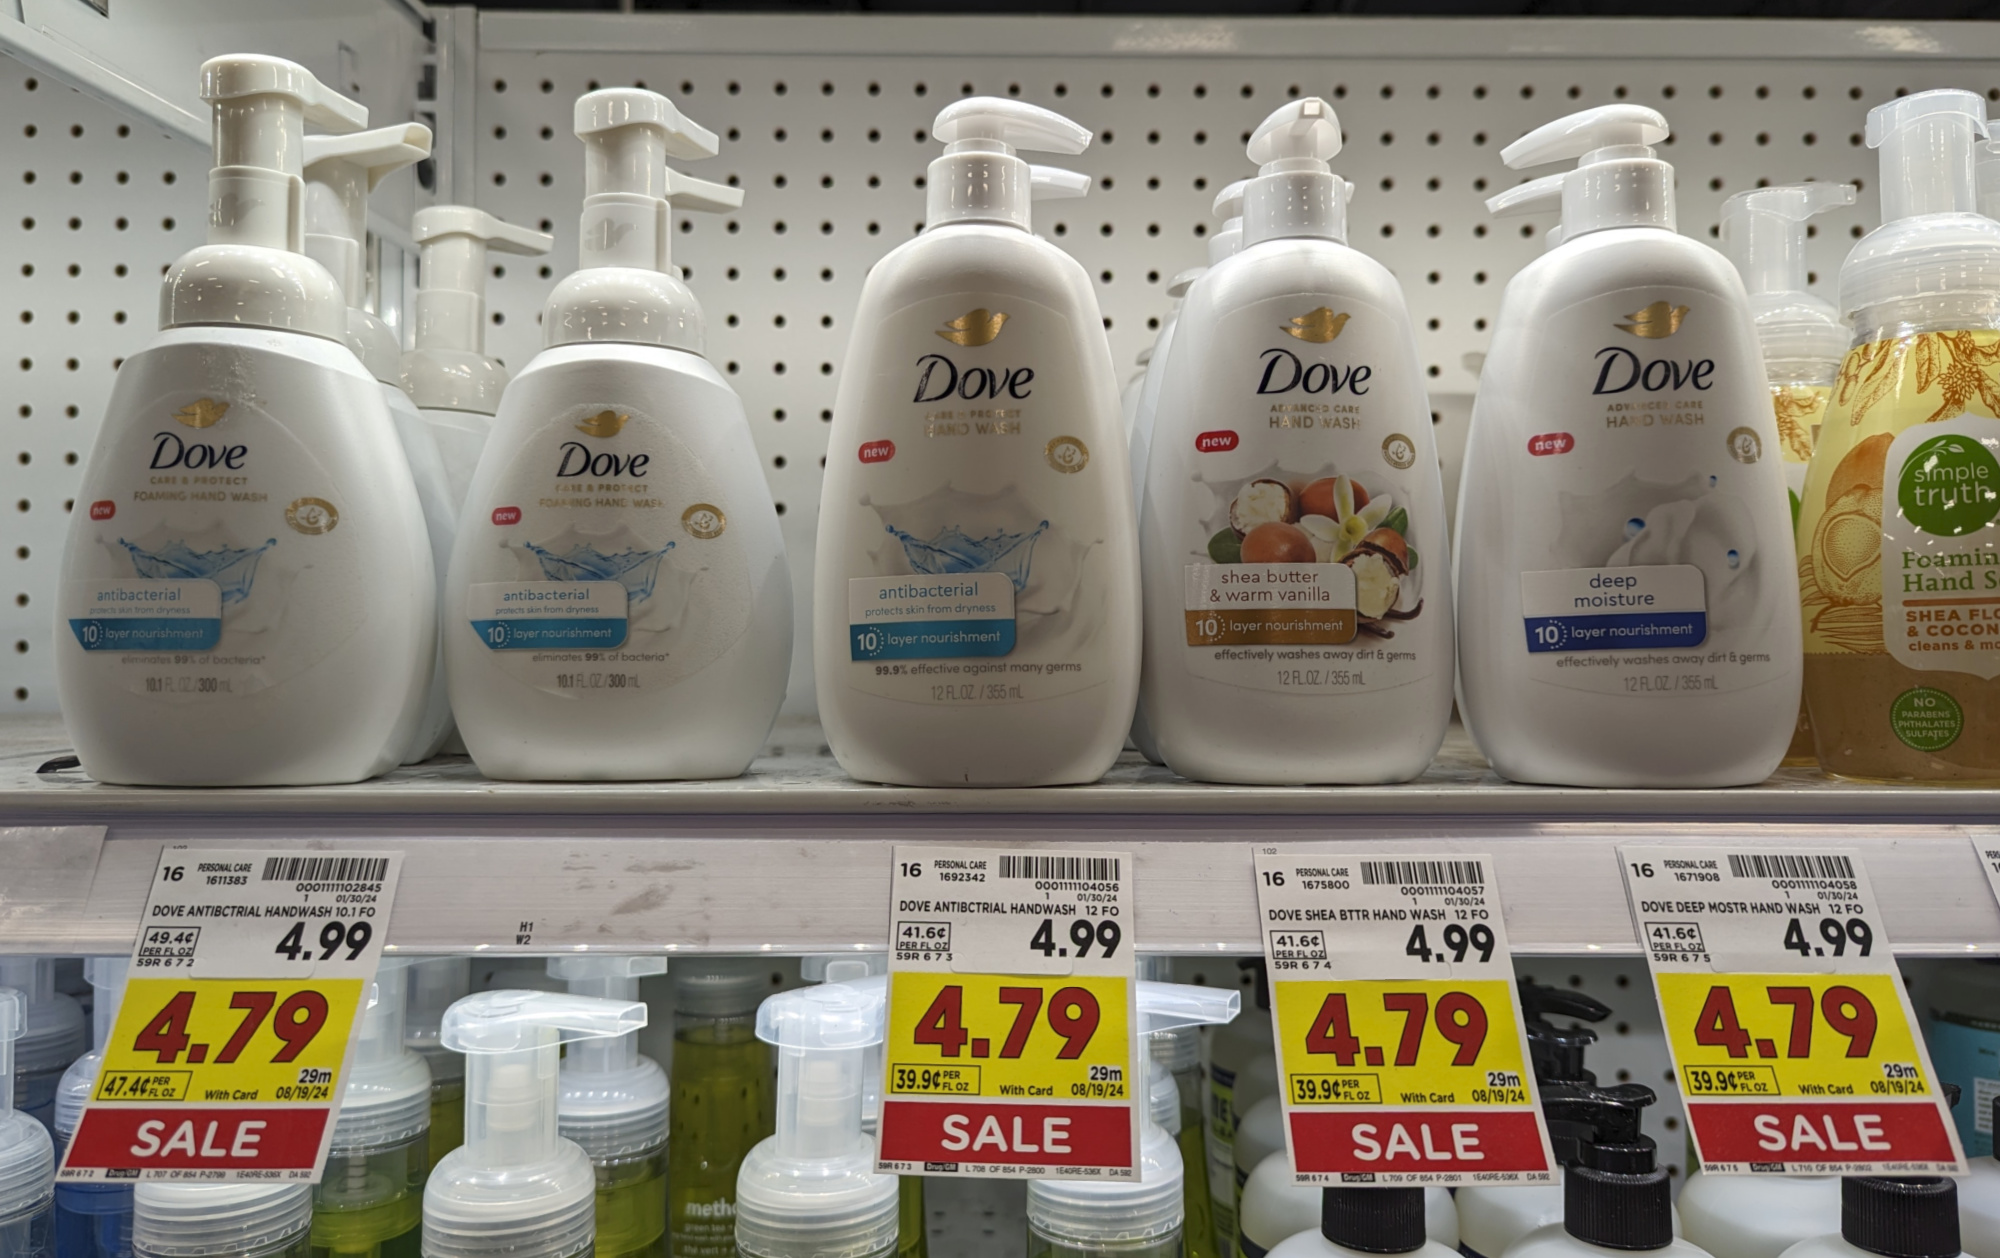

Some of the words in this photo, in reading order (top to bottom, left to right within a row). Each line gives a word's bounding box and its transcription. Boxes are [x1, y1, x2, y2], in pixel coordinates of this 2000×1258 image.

[1257, 349, 1372, 395] Dove
[1592, 346, 1715, 395] Dove
[913, 354, 1035, 403] Dove
[1202, 435, 1232, 448] new
[1535, 438, 1567, 450] new
[150, 432, 248, 469] Dove
[864, 446, 889, 458] new
[557, 442, 649, 477] Dove
[1914, 462, 1989, 483] simple
[1914, 481, 1992, 506] truth
[1221, 570, 1260, 584] shea
[1267, 569, 1319, 583] butter
[1590, 574, 1637, 591] deep
[1903, 571, 1975, 592] Hand
[97, 588, 181, 601] antibacterial
[504, 589, 590, 601] antibacterial
[879, 581, 978, 600] antibacterial
[1210, 589, 1221, 602] &
[1226, 590, 1273, 602] warm
[1278, 587, 1330, 601] vanilla
[1574, 592, 1655, 608] moisture
[1906, 610, 1961, 622] SHEA
[82, 625, 97, 643] 10
[105, 628, 130, 640] layer
[132, 628, 203, 638] nourishment
[487, 626, 504, 643] 10
[514, 628, 539, 640] layer
[542, 628, 612, 638] nourishment
[1195, 619, 1218, 636] 10
[1230, 620, 1262, 634] layer
[1265, 619, 1343, 632] nourishment
[1534, 626, 1559, 644] 10
[1571, 626, 1605, 640] layer
[1610, 623, 1693, 637] nourishment
[1907, 625, 1918, 637] &
[857, 632, 877, 651] 10
[887, 633, 918, 647] layer
[921, 631, 1001, 644] nourishment
[1908, 641, 1959, 652] cleans
[1964, 640, 1975, 650] &
[1214, 649, 1274, 662] effectively
[1277, 650, 1320, 660] washes
[1323, 651, 1354, 662] away
[1356, 650, 1375, 660] dirt
[1376, 650, 1384, 660] &
[1386, 652, 1416, 662] germs
[1556, 655, 1620, 668] effectively
[1623, 654, 1669, 665] washes
[1672, 654, 1705, 665] away
[1708, 653, 1727, 663] dirt
[1729, 653, 1737, 663] &
[1739, 653, 1771, 665] germs
[875, 664, 908, 676] 99.9%
[911, 663, 960, 675] effective
[963, 662, 1007, 676] against
[1010, 663, 1042, 675] many
[1045, 662, 1082, 674] germs
[1913, 698, 1936, 708] NO
[1905, 730, 1950, 738] SULFATES
[198, 863, 232, 872] PERSONAL
[234, 863, 252, 872] CARE
[901, 863, 922, 877] 16
[934, 860, 968, 869] PERSONAL
[970, 862, 987, 870] CARE
[1631, 863, 1655, 878] 16
[1663, 860, 1698, 869] PERSONAL
[1699, 860, 1718, 870] CARE
[163, 866, 184, 882] 16
[940, 873, 985, 882] 1692342
[1263, 872, 1285, 886] 16
[1296, 868, 1330, 877] PERSONAL
[1332, 868, 1349, 877] CARE
[1675, 873, 1720, 882] 1671908
[206, 876, 248, 885] 1611383
[1035, 882, 1119, 891] 0001111104056
[1302, 880, 1350, 890] 1675800
[1772, 880, 1857, 890] 0001111104058
[296, 883, 381, 893] 0001111102845
[1401, 886, 1484, 896] 0001111104057
[336, 894, 377, 903] 01/30/24
[1077, 893, 1117, 902] 01/30/24
[1445, 897, 1485, 906] 01/30/24
[1817, 891, 1858, 901] 01/30/24
[152, 906, 185, 917] DOVE
[187, 906, 262, 917] ANTIBCTRIAL
[265, 906, 332, 917] HANDWASH
[336, 907, 357, 917] 10.1
[359, 907, 376, 917] FO
[900, 901, 931, 912] DOVE
[934, 902, 1007, 913] ANTIBCTRIAL
[1011, 904, 1076, 915] HANDWASH
[1085, 906, 1098, 915] 12
[1102, 906, 1119, 916] FO
[1269, 909, 1302, 920] DOVE
[1305, 909, 1336, 920] SHEA
[1340, 909, 1370, 920] BTTR
[1373, 909, 1407, 920] HAND
[1410, 909, 1446, 920] WASH
[1455, 910, 1467, 920] 12
[1471, 910, 1489, 920] FO
[1641, 901, 1674, 912] DOVE
[1677, 902, 1705, 912] DEEP
[1709, 902, 1748, 913] MOSTR
[1751, 903, 1783, 914] HAND
[1786, 903, 1821, 914] WASH
[1829, 904, 1843, 914] 12
[1846, 904, 1863, 914] FO
[519, 921, 533, 932] H1
[902, 927, 946, 939] 41.6¢
[1653, 927, 1697, 940] 41.6¢
[148, 931, 194, 945] 49.4¢
[275, 921, 373, 961] 4.99
[516, 934, 531, 945] W2
[1030, 919, 1121, 958] 4.99
[1276, 935, 1320, 947] 41.6¢
[1406, 924, 1495, 963] 4.99
[1784, 918, 1873, 957] 4.99
[133, 990, 329, 1064] 4.79
[914, 985, 1100, 1060] 4.79
[1694, 985, 1878, 1058] 4.79
[1305, 991, 1489, 1067] 4.79
[299, 1069, 332, 1084] 29m
[1090, 1066, 1122, 1081] 29m
[1883, 1064, 1918, 1078] 29m
[896, 1069, 941, 1089] 39.9¢
[1488, 1072, 1520, 1087] 29m
[1690, 1070, 1737, 1091] 39.9¢
[104, 1076, 150, 1097] 47.4¢
[276, 1086, 329, 1100] 08/19/24
[1000, 1084, 1025, 1095] With
[1028, 1085, 1053, 1096] Card
[1071, 1083, 1124, 1097] 08/19/24
[1296, 1079, 1341, 1099] 39.9¢
[1798, 1083, 1826, 1095] With
[1827, 1083, 1854, 1095] Card
[1870, 1081, 1925, 1094] 08/19/24
[204, 1089, 230, 1100] With
[232, 1089, 258, 1100] Card
[1401, 1092, 1427, 1103] With
[1429, 1092, 1455, 1104] Card
[1472, 1089, 1525, 1104] 08/19/24
[130, 1120, 267, 1157] SALE
[941, 1114, 1072, 1154] SALE
[1753, 1114, 1892, 1151] SALE
[1352, 1123, 1485, 1161] SALE
